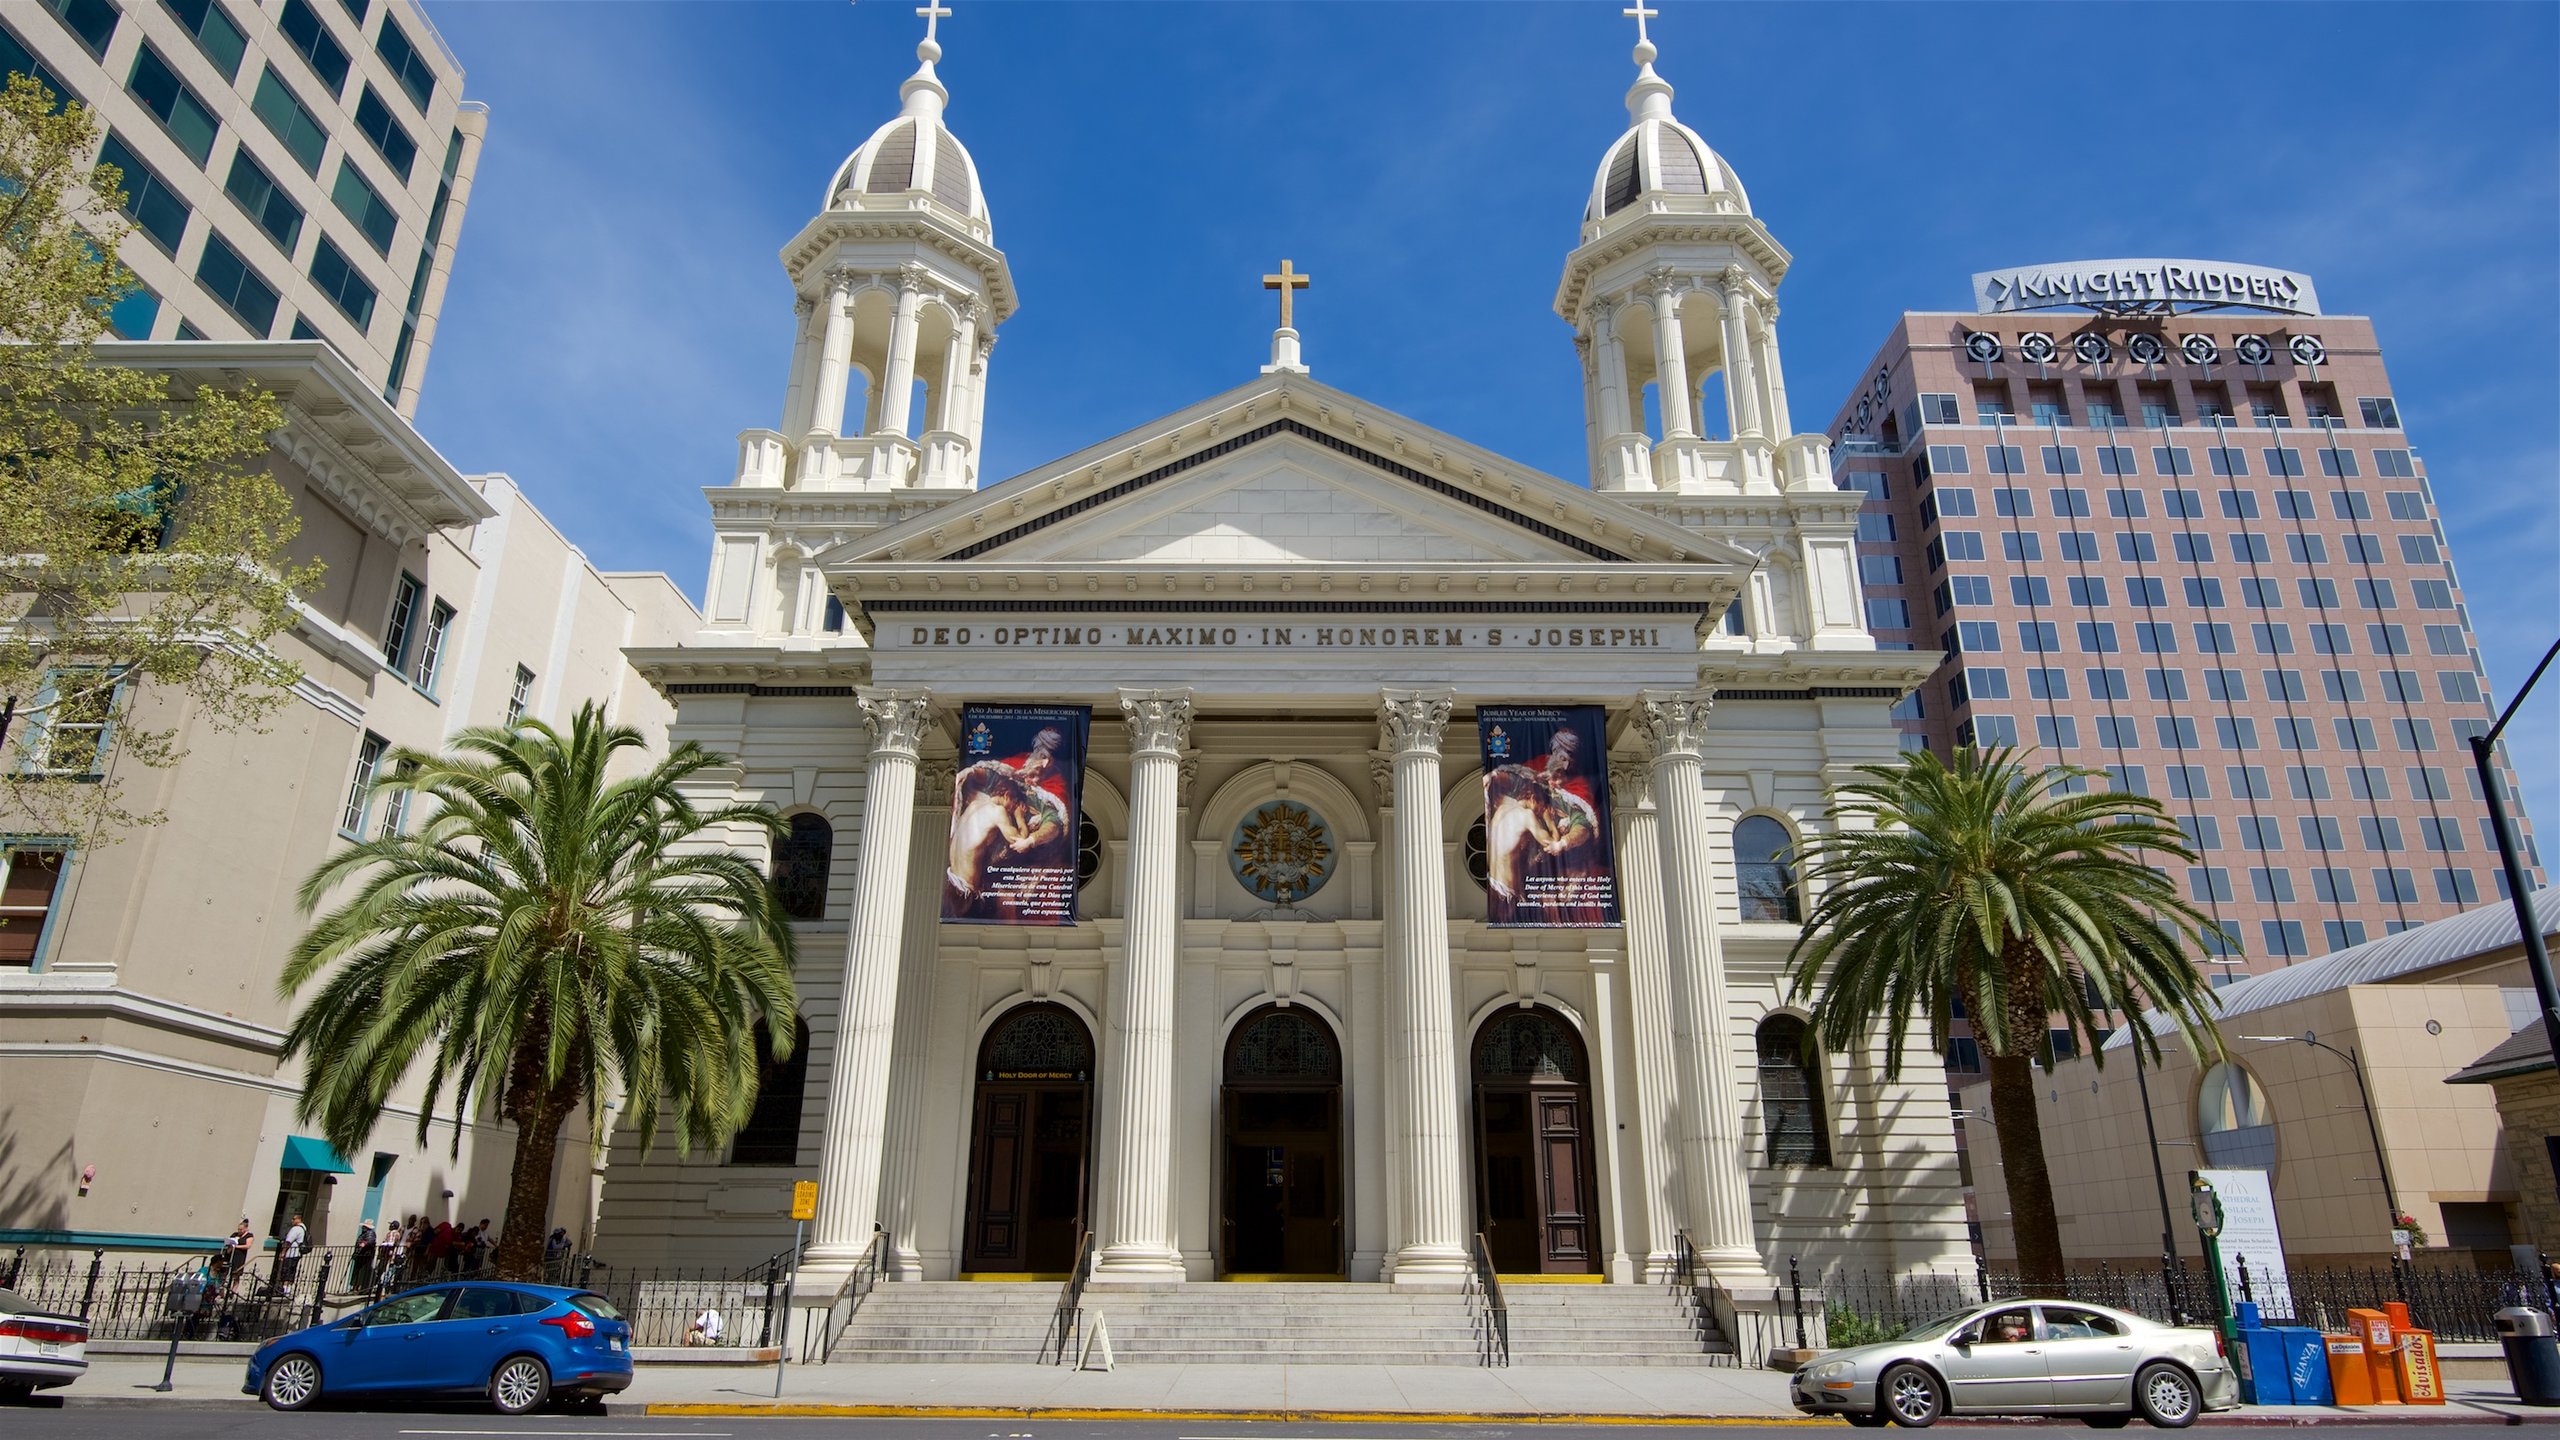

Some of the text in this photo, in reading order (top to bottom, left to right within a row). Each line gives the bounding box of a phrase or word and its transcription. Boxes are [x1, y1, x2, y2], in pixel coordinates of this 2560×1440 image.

[912, 627, 1659, 646] DEO OPTIMO MAXIMO IN HONOREM S JOSEPHI
[986, 706, 1013, 714] JUBILAR
[1033, 707, 1080, 716] MISERICORDIA
[1483, 709, 1507, 717] JUBILEE
[1537, 709, 1561, 717] MERCY
[987, 865, 999, 873] Que
[999, 866, 1030, 874] cualquiera
[2233, 1216, 2265, 1224] JOSEPH
[2371, 1320, 2388, 1328] AUTO
[2293, 1343, 2319, 1388] ALIANZA
